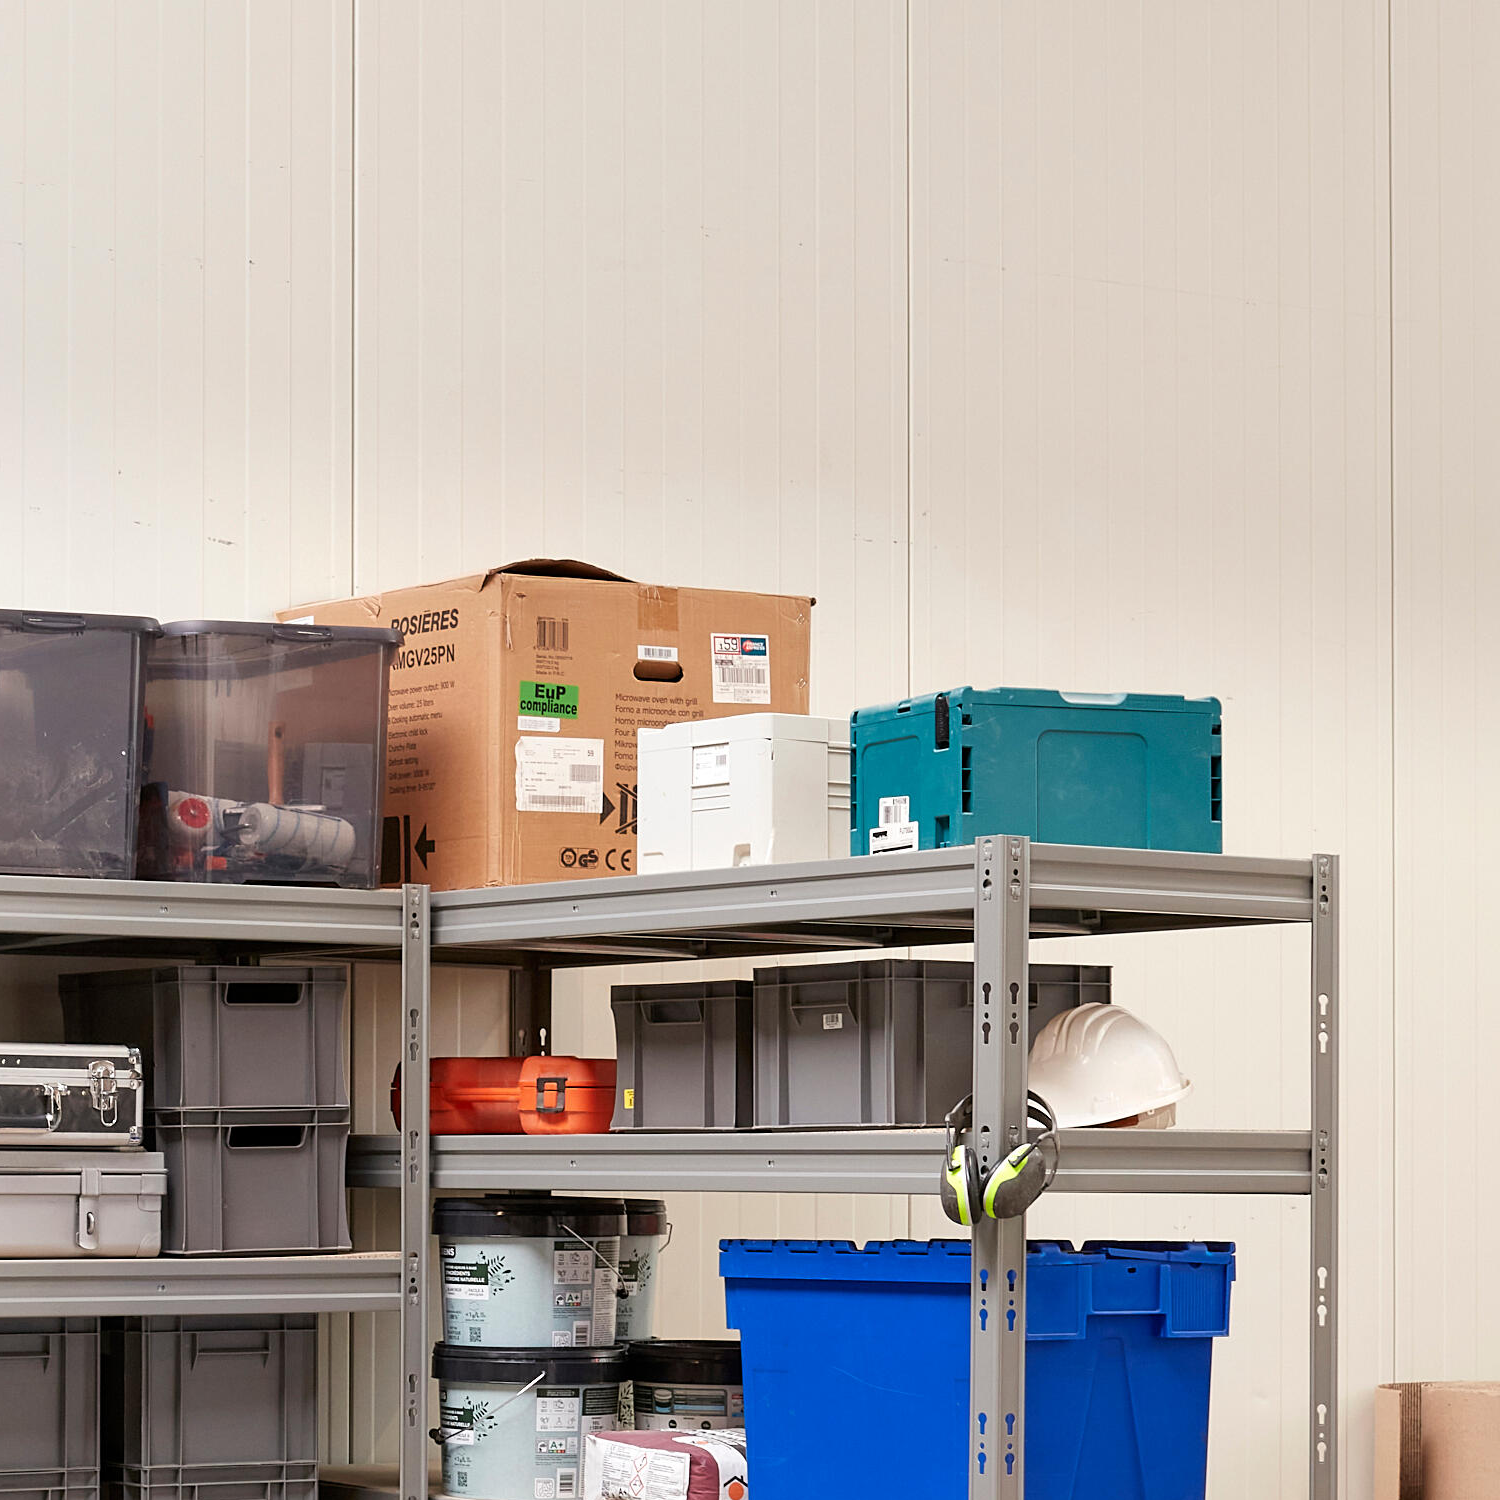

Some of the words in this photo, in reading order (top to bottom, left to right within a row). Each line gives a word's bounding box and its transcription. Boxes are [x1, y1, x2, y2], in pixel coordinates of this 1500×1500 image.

[535, 683, 566, 700] EuP
[615, 693, 651, 703] Microwave
[652, 696, 668, 704] oven
[685, 698, 698, 707] grill
[520, 699, 578, 715] compliance
[615, 705, 635, 714] Forno
[642, 708, 677, 716] microonde
[691, 710, 704, 718] grill
[615, 717, 636, 725] Horno
[637, 718, 670, 727] microond
[567, 1294, 579, 1302] A+
[550, 1441, 563, 1449] A+
